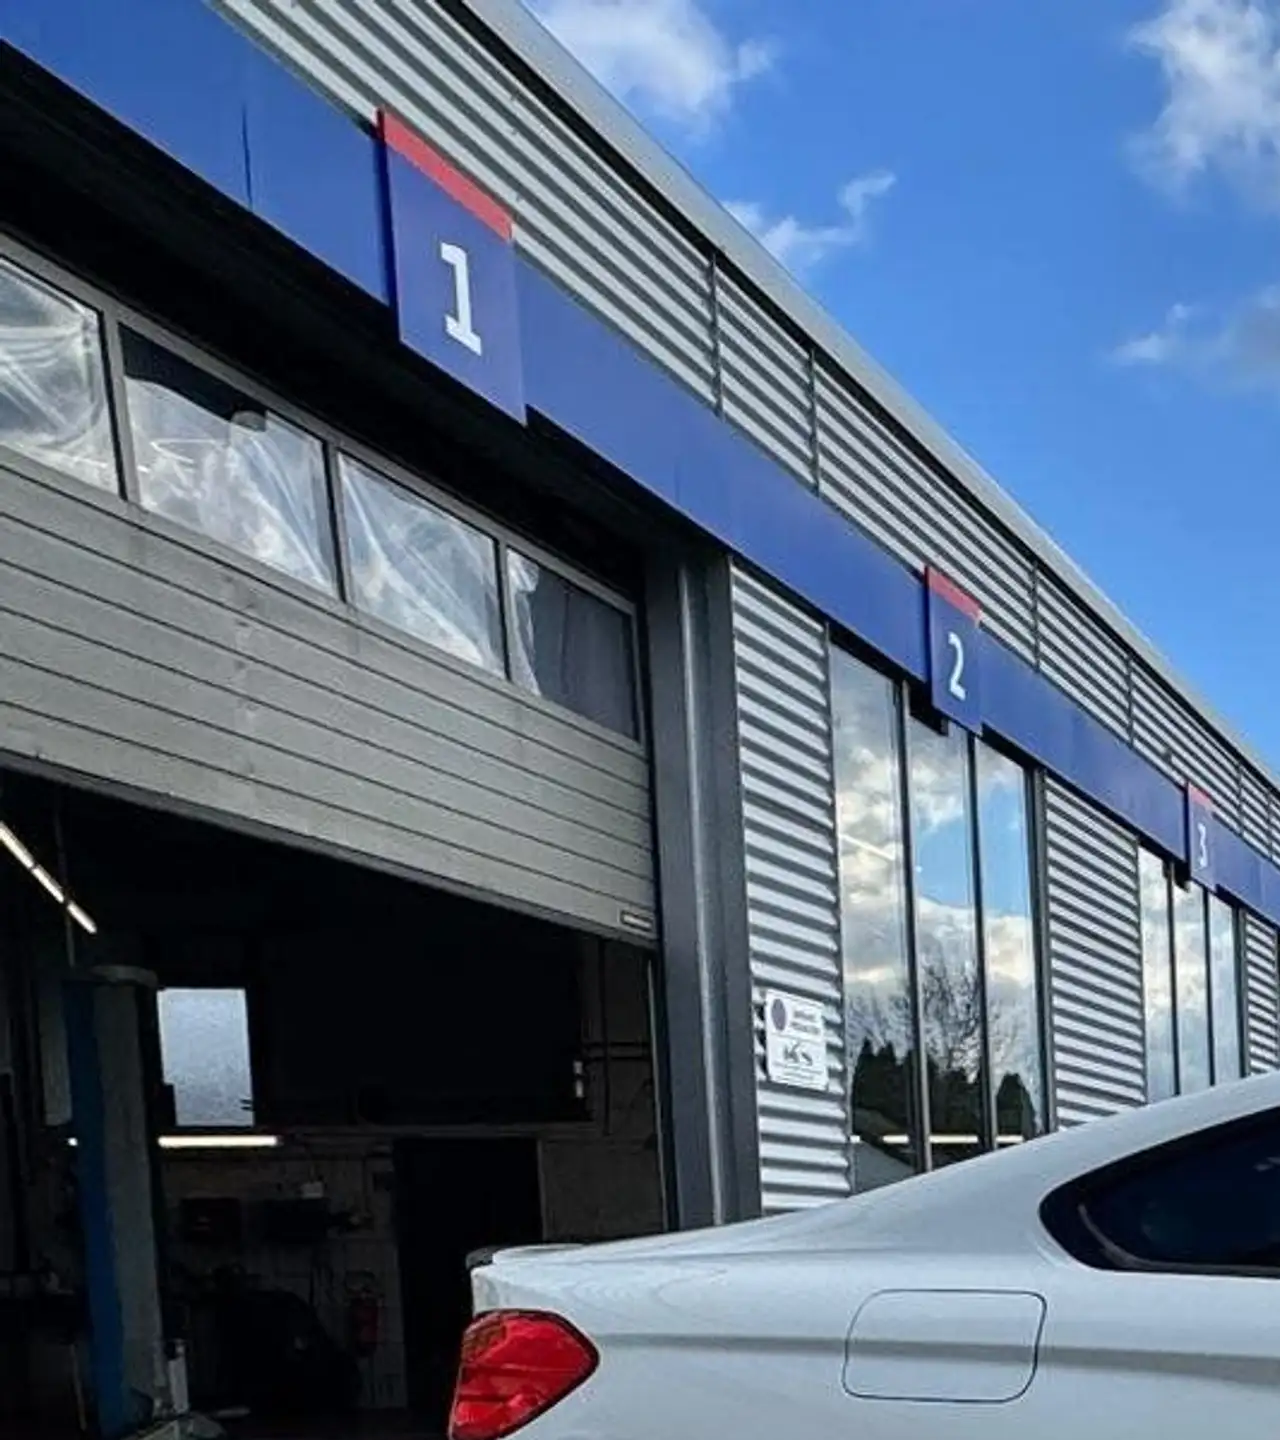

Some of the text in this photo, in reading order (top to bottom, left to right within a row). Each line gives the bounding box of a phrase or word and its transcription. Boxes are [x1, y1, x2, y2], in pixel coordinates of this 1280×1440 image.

[440, 242, 482, 356] 1
[947, 631, 966, 700] 2
[1197, 823, 1208, 870] 3
